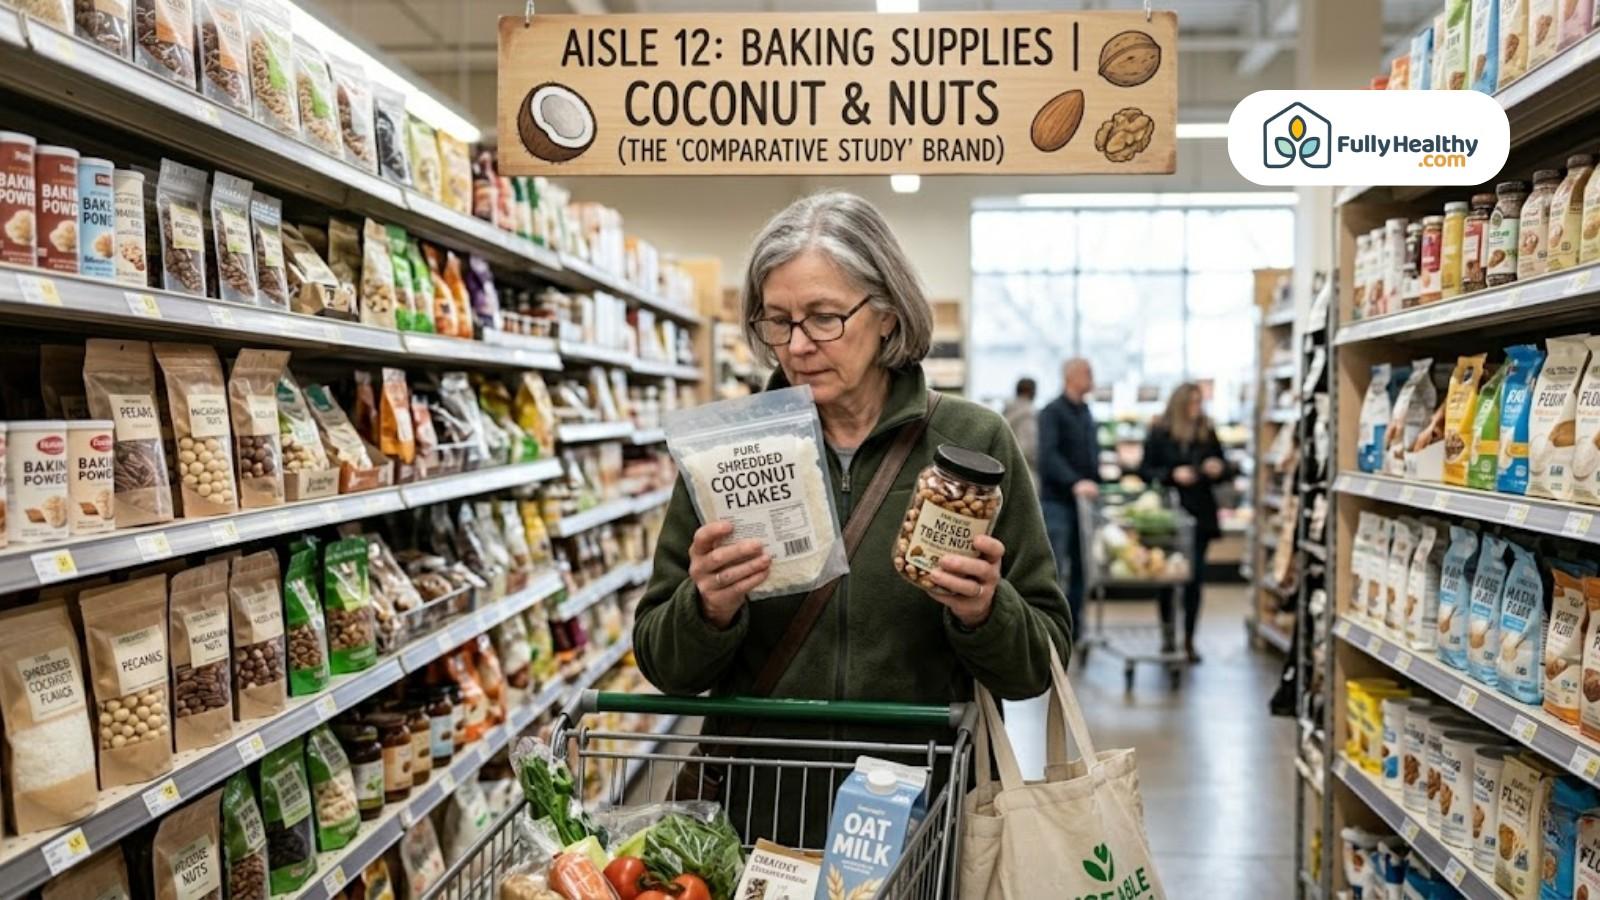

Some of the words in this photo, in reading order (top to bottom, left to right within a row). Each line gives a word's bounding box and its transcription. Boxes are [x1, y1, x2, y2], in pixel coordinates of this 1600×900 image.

[562, 29, 656, 67] AISLE
[674, 29, 723, 66] 12:
[741, 28, 874, 66] BAKING
[890, 28, 1054, 66] SUPPLIES
[625, 80, 825, 127] COCONUT
[842, 81, 870, 126] &
[889, 80, 998, 126] NUTS
[617, 138, 667, 166] (THE
[676, 138, 828, 163] 'COMPARATIVE
[838, 138, 913, 163] STUDY'
[923, 138, 1005, 165] BRAND)
[717, 452, 783, 475] SHREDDED
[733, 443, 760, 457] PURE
[711, 463, 796, 494] COCONUT
[725, 483, 792, 510] FLAKES
[948, 537, 977, 552] NUT
[843, 812, 893, 841] OAT
[832, 833, 893, 867] MILK
